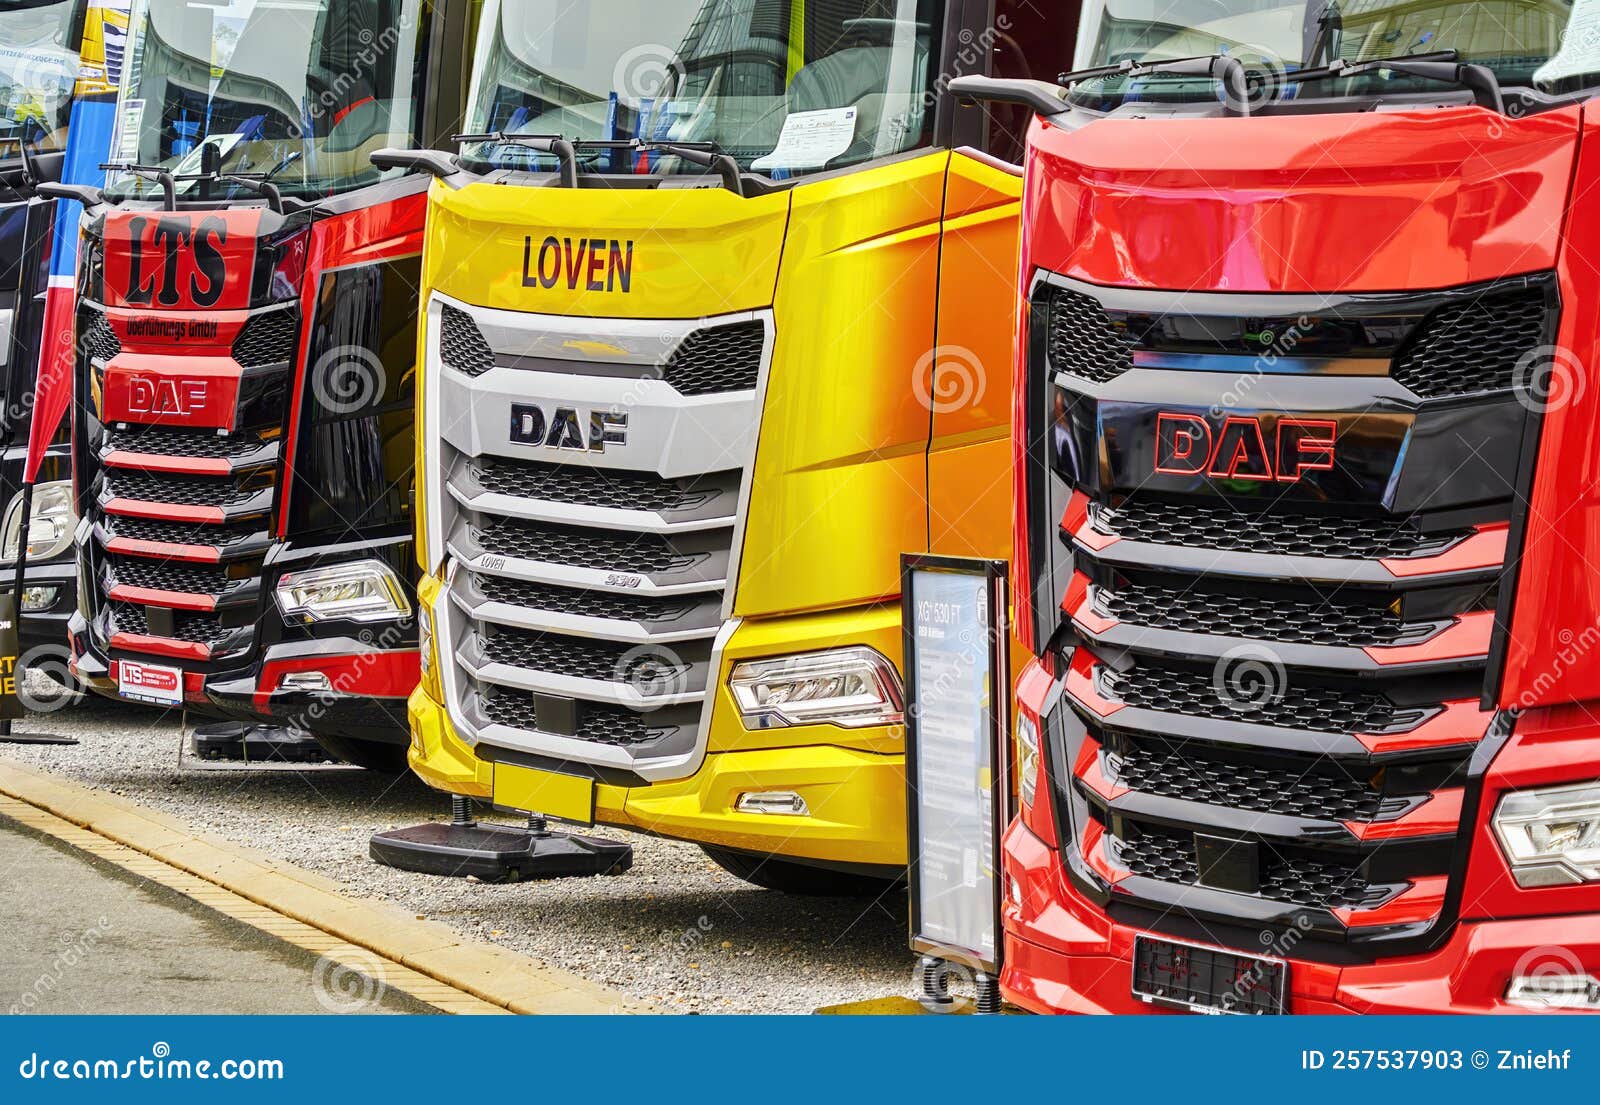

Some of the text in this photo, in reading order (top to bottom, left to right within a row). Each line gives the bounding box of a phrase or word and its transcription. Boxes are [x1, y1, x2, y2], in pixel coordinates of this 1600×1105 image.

[124, 214, 228, 308] LTS
[521, 235, 634, 293] LOVEN
[126, 315, 218, 342] Überführungs GmbH
[128, 377, 209, 415] DAF
[509, 401, 629, 454] DAF
[1153, 410, 1338, 483] DAF
[480, 555, 506, 571] LOVEN
[122, 662, 143, 685] LTS
